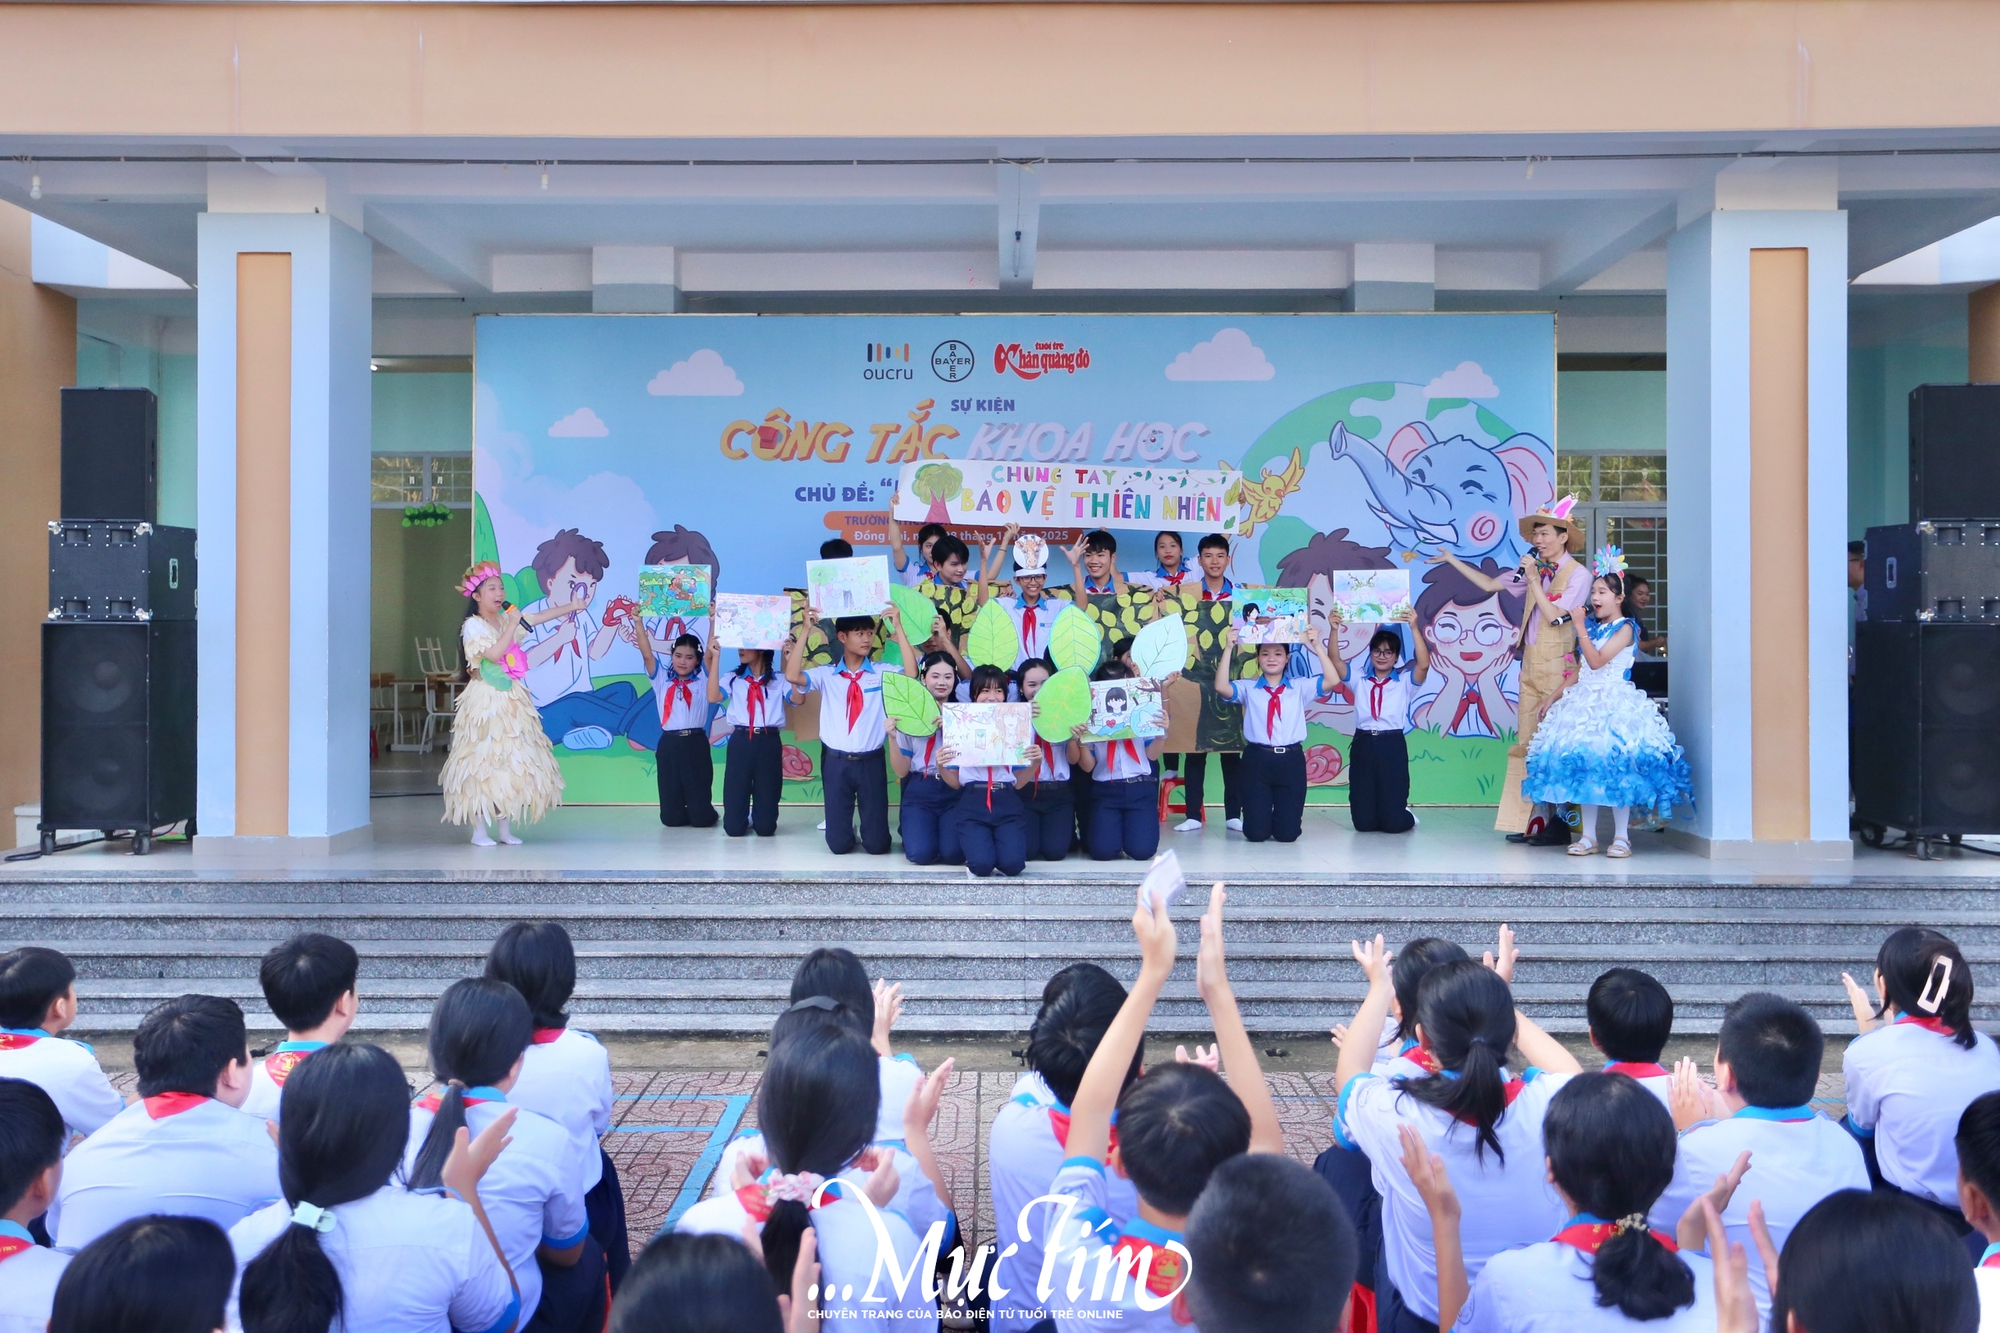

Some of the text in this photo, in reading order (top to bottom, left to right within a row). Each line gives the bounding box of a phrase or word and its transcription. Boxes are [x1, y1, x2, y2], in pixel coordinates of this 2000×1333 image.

[935, 357, 971, 365] BAYER
[1076, 347, 1090, 368] đỏ
[863, 368, 913, 380] oucru
[950, 396, 1015, 414] SỰ KIỆN
[719, 398, 961, 464] CÔNG TẮC
[964, 421, 1097, 463] KHOA
[991, 465, 1117, 485] CHUNG TAY
[794, 482, 836, 502] CHỦ
[841, 481, 875, 502] ĐỀ:
[961, 480, 1012, 514] BẢO
[1020, 485, 1057, 521] VỆ
[854, 529, 885, 543] Đồng
[1041, 531, 1068, 540] 2025
